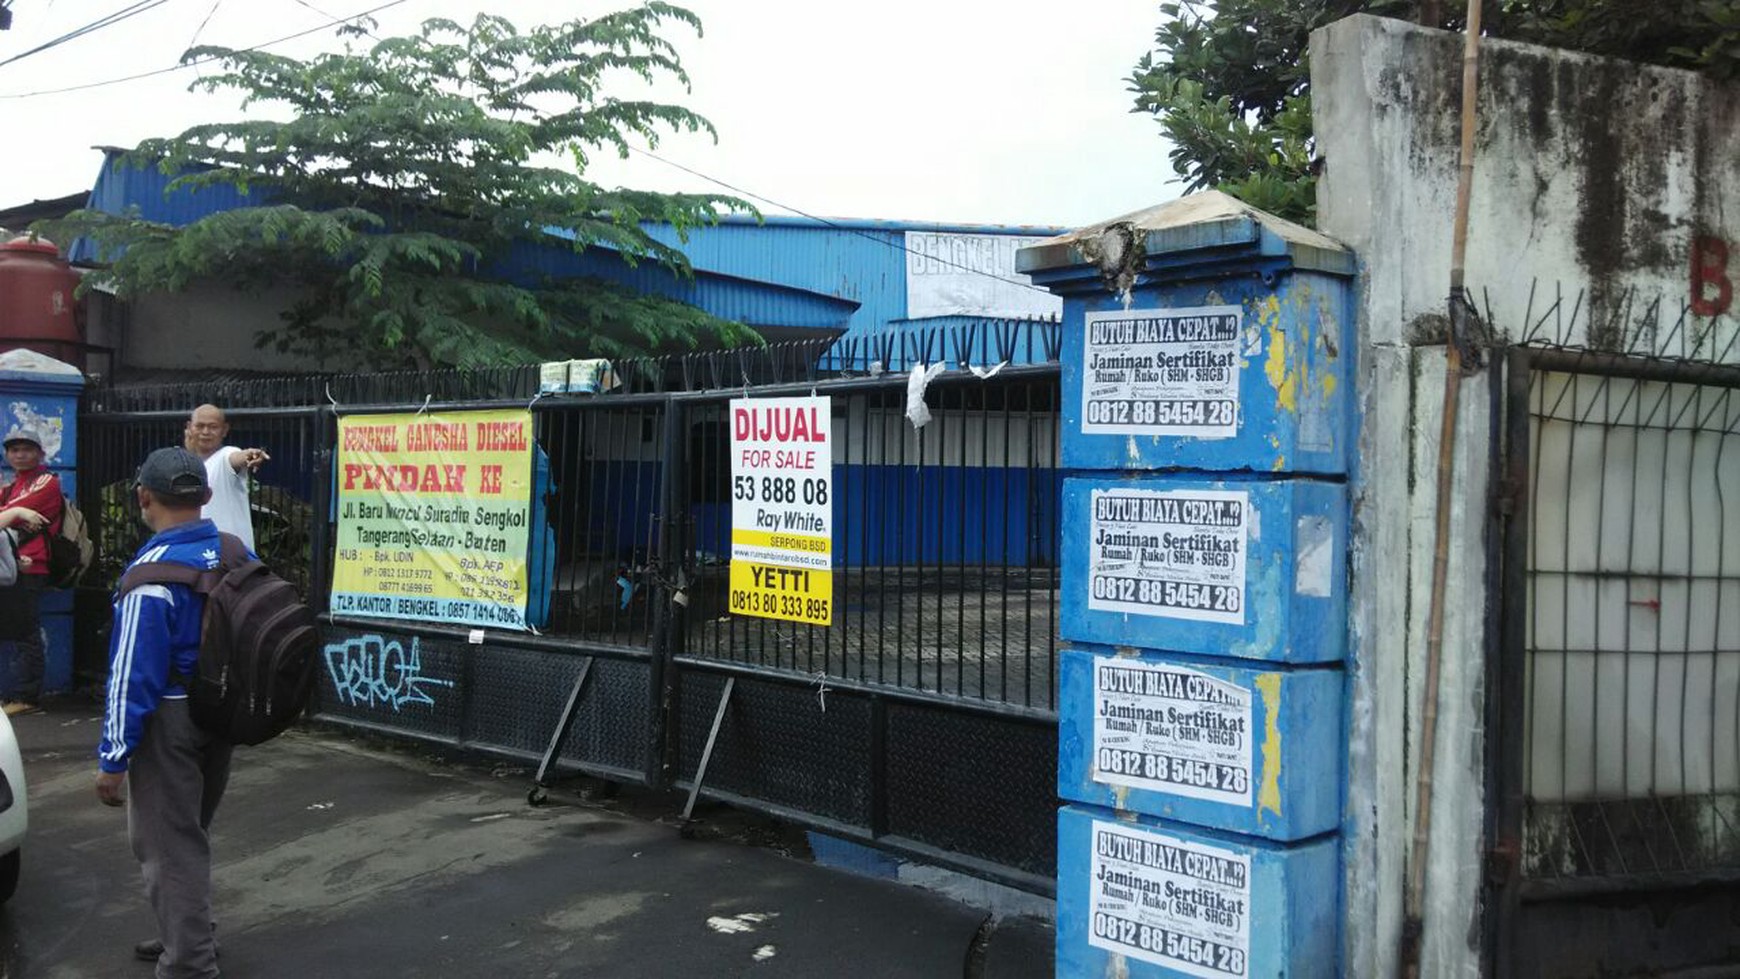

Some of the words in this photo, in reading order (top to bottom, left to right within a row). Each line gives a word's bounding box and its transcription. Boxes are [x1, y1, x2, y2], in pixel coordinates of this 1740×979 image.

[911, 234, 1003, 275] BENGKEL
[1691, 236, 1732, 316] B
[1092, 320, 1134, 344] BUTUH
[1136, 319, 1174, 343] BIAYA
[1090, 354, 1152, 370] Jaminan
[1157, 351, 1234, 368] Sertifikat
[1094, 370, 1126, 383] Rumah
[1134, 370, 1159, 382] Ruko
[1167, 368, 1189, 382] SHM
[1195, 368, 1223, 382] SHGB
[735, 408, 825, 442] DIJUAL
[1089, 401, 1128, 424] 0812
[1134, 401, 1155, 424] 88
[1160, 402, 1205, 424] 5454
[1208, 402, 1232, 424] 28
[344, 425, 398, 453] BENGKEL
[407, 422, 468, 451] GANESHA
[477, 422, 526, 451] DIESEL
[742, 450, 770, 468] FOR
[775, 451, 815, 469] SALE
[344, 464, 466, 493] PINDAH
[480, 465, 502, 494] KE
[734, 476, 754, 500] 53
[762, 477, 795, 503] 888
[803, 478, 828, 505] 08
[343, 502, 355, 519] Jl.
[360, 503, 382, 518] Baru
[474, 507, 525, 530] Sengkol
[757, 508, 781, 532] Ray
[784, 511, 822, 531] White
[1098, 498, 1140, 521] BUTUH
[1142, 499, 1179, 522] BIAYA
[357, 526, 411, 548] Tangerang
[770, 536, 807, 550] SERPONG
[809, 539, 826, 551] BSD
[1096, 529, 1158, 547] Jaminan
[1163, 532, 1239, 553] Sertifikat
[394, 552, 413, 562] UDIN
[1102, 546, 1132, 559] Rumah
[1141, 549, 1165, 562] Ruko
[1174, 550, 1194, 565] SHM
[1202, 552, 1229, 567] SHGB
[751, 566, 809, 592] YETTI
[357, 597, 391, 612] KANTOR
[398, 599, 439, 616] BENGKEL
[448, 604, 470, 618] 0857
[732, 590, 759, 611] 0813
[763, 593, 777, 614] 80
[781, 596, 802, 617] 333
[806, 599, 828, 620] 895
[1095, 577, 1135, 600] 0812
[1140, 580, 1161, 604] 88
[1165, 583, 1211, 609] 5454
[1214, 587, 1239, 612] 28
[1100, 668, 1143, 692] BUTUH
[1146, 672, 1184, 698] BIAYA
[1100, 700, 1163, 722] Jaminan
[1168, 707, 1244, 733] Sertifikat
[1106, 718, 1137, 733] Rumah
[1146, 722, 1170, 738] Ruko
[1179, 727, 1199, 742] SHM
[1207, 729, 1235, 746] SHGB
[1100, 749, 1141, 775] 0812
[1145, 755, 1168, 779] 88
[1172, 758, 1217, 787] 5454
[1222, 766, 1246, 792] 28
[1099, 832, 1141, 863] BUTUH
[1144, 842, 1183, 873] BIAYA
[1097, 865, 1160, 894] Jaminan
[1165, 881, 1244, 915] Sertifikat
[1102, 882, 1134, 903] Rumah
[1142, 892, 1166, 910] Ruko
[1176, 901, 1197, 918] SHM
[1205, 909, 1233, 927] SHGB
[1095, 914, 1137, 944] 0812
[1140, 926, 1163, 952] 88
[1167, 932, 1214, 966] 5454
[1218, 947, 1244, 974] 28
